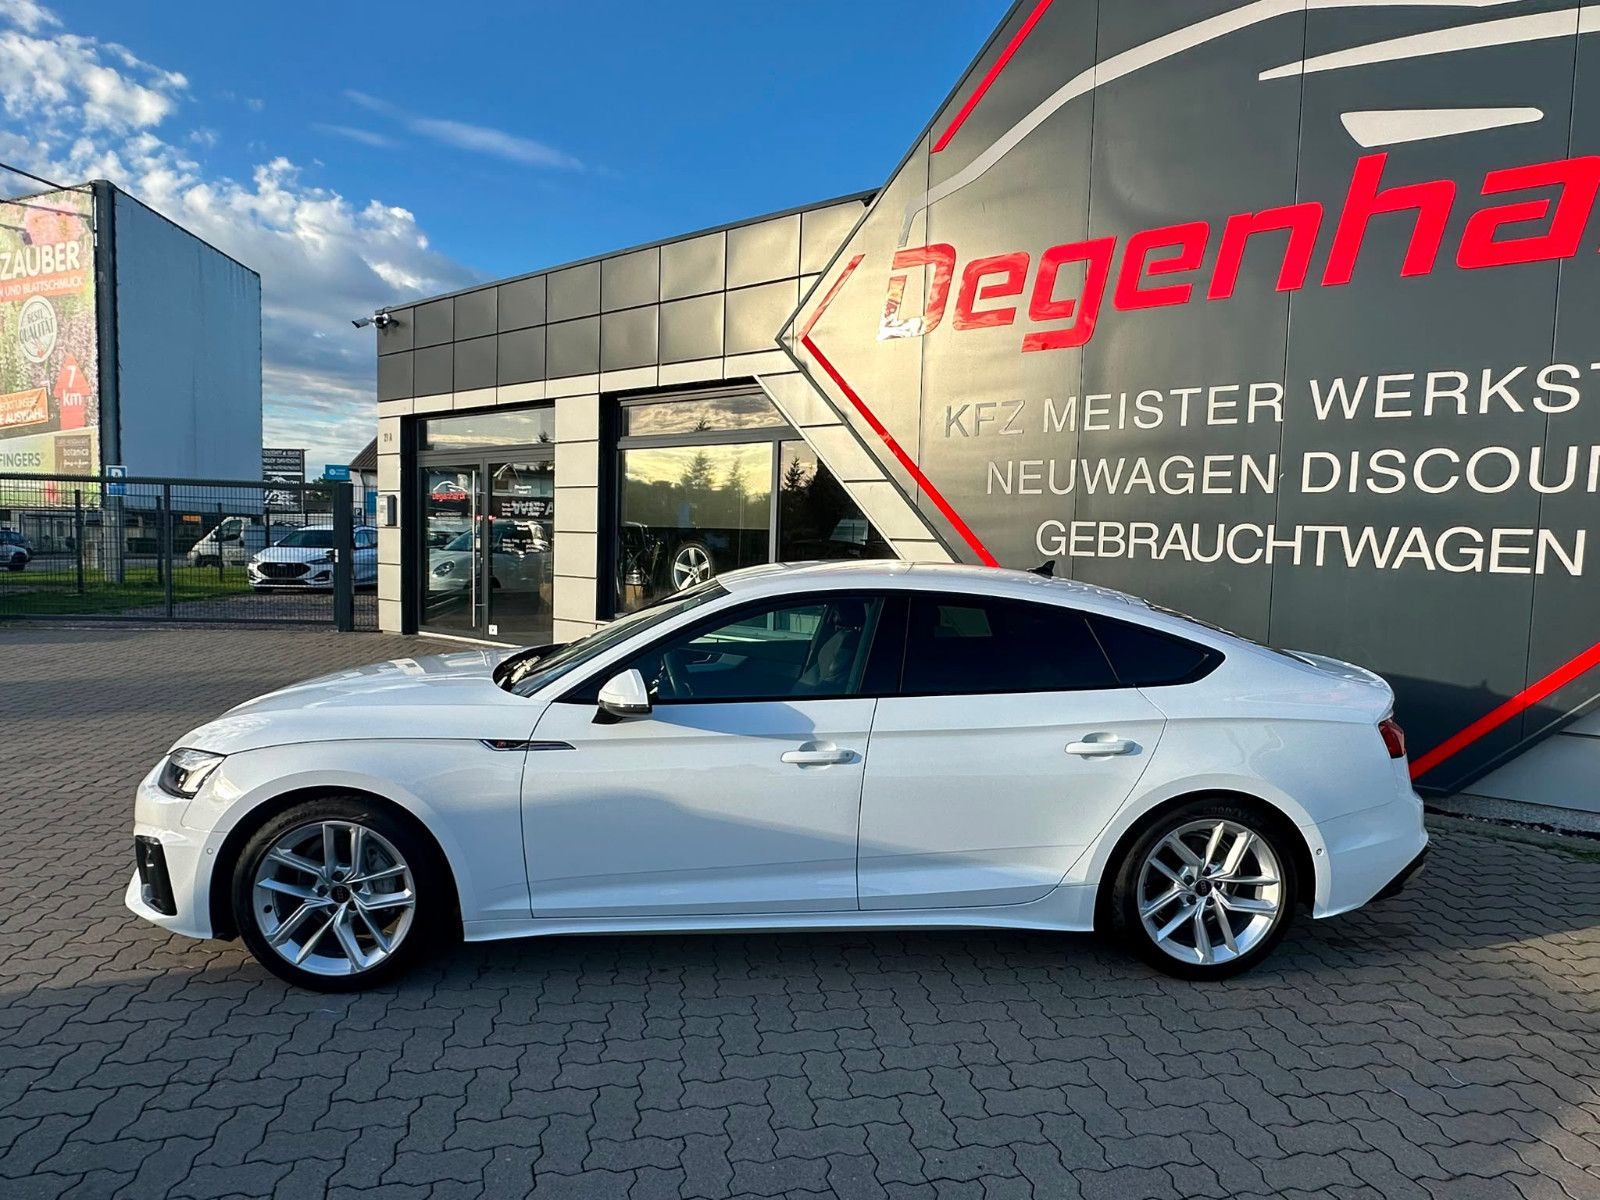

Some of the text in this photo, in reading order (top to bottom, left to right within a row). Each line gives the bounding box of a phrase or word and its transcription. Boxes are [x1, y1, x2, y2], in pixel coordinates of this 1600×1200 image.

[0, 240, 80, 280] ZAUBER
[877, 152, 1600, 352] Degenha
[63, 389, 82, 406] km
[67, 365, 76, 388] 7
[945, 362, 1600, 437] KFZ MEISTER WERKS
[986, 445, 1600, 495] NEUWAGEN DISCOU
[1035, 519, 1586, 577] GEBRAUCHTWAGEN
